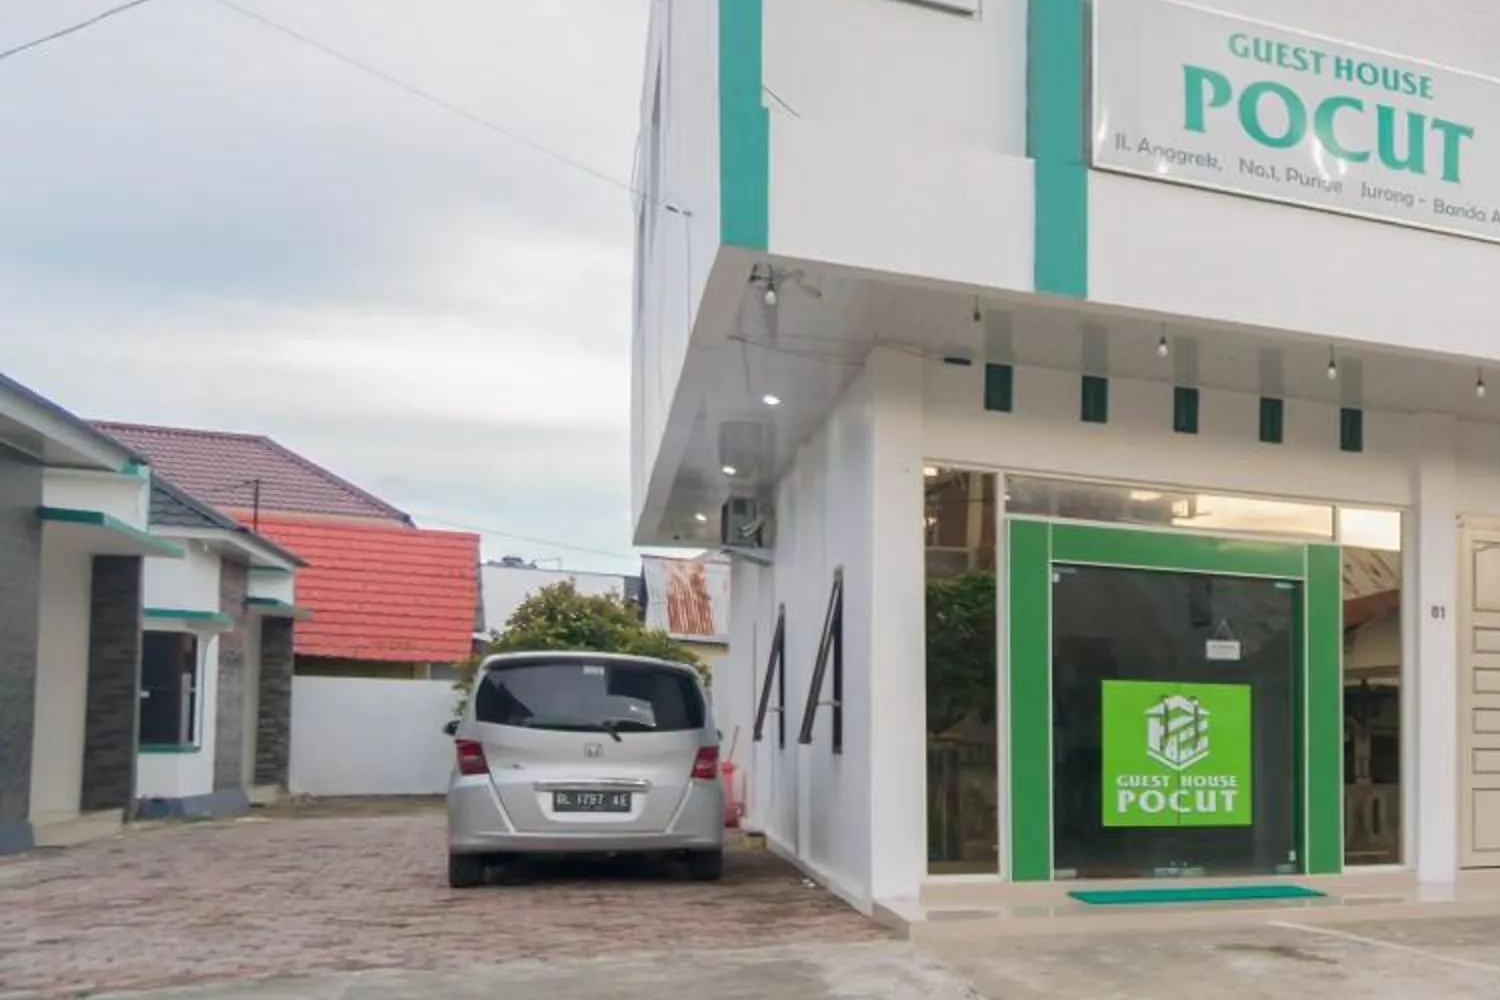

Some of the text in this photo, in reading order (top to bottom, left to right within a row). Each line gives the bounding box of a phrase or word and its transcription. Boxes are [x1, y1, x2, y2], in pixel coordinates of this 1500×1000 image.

[1228, 32, 1435, 100] GUEST HOUSE
[1181, 63, 1475, 184] POCUT
[1361, 181, 1415, 207] Jurong
[1434, 198, 1487, 222] Banda
[1116, 775, 1239, 787] GUEST HOUSE
[1117, 790, 1238, 813] POCUT
